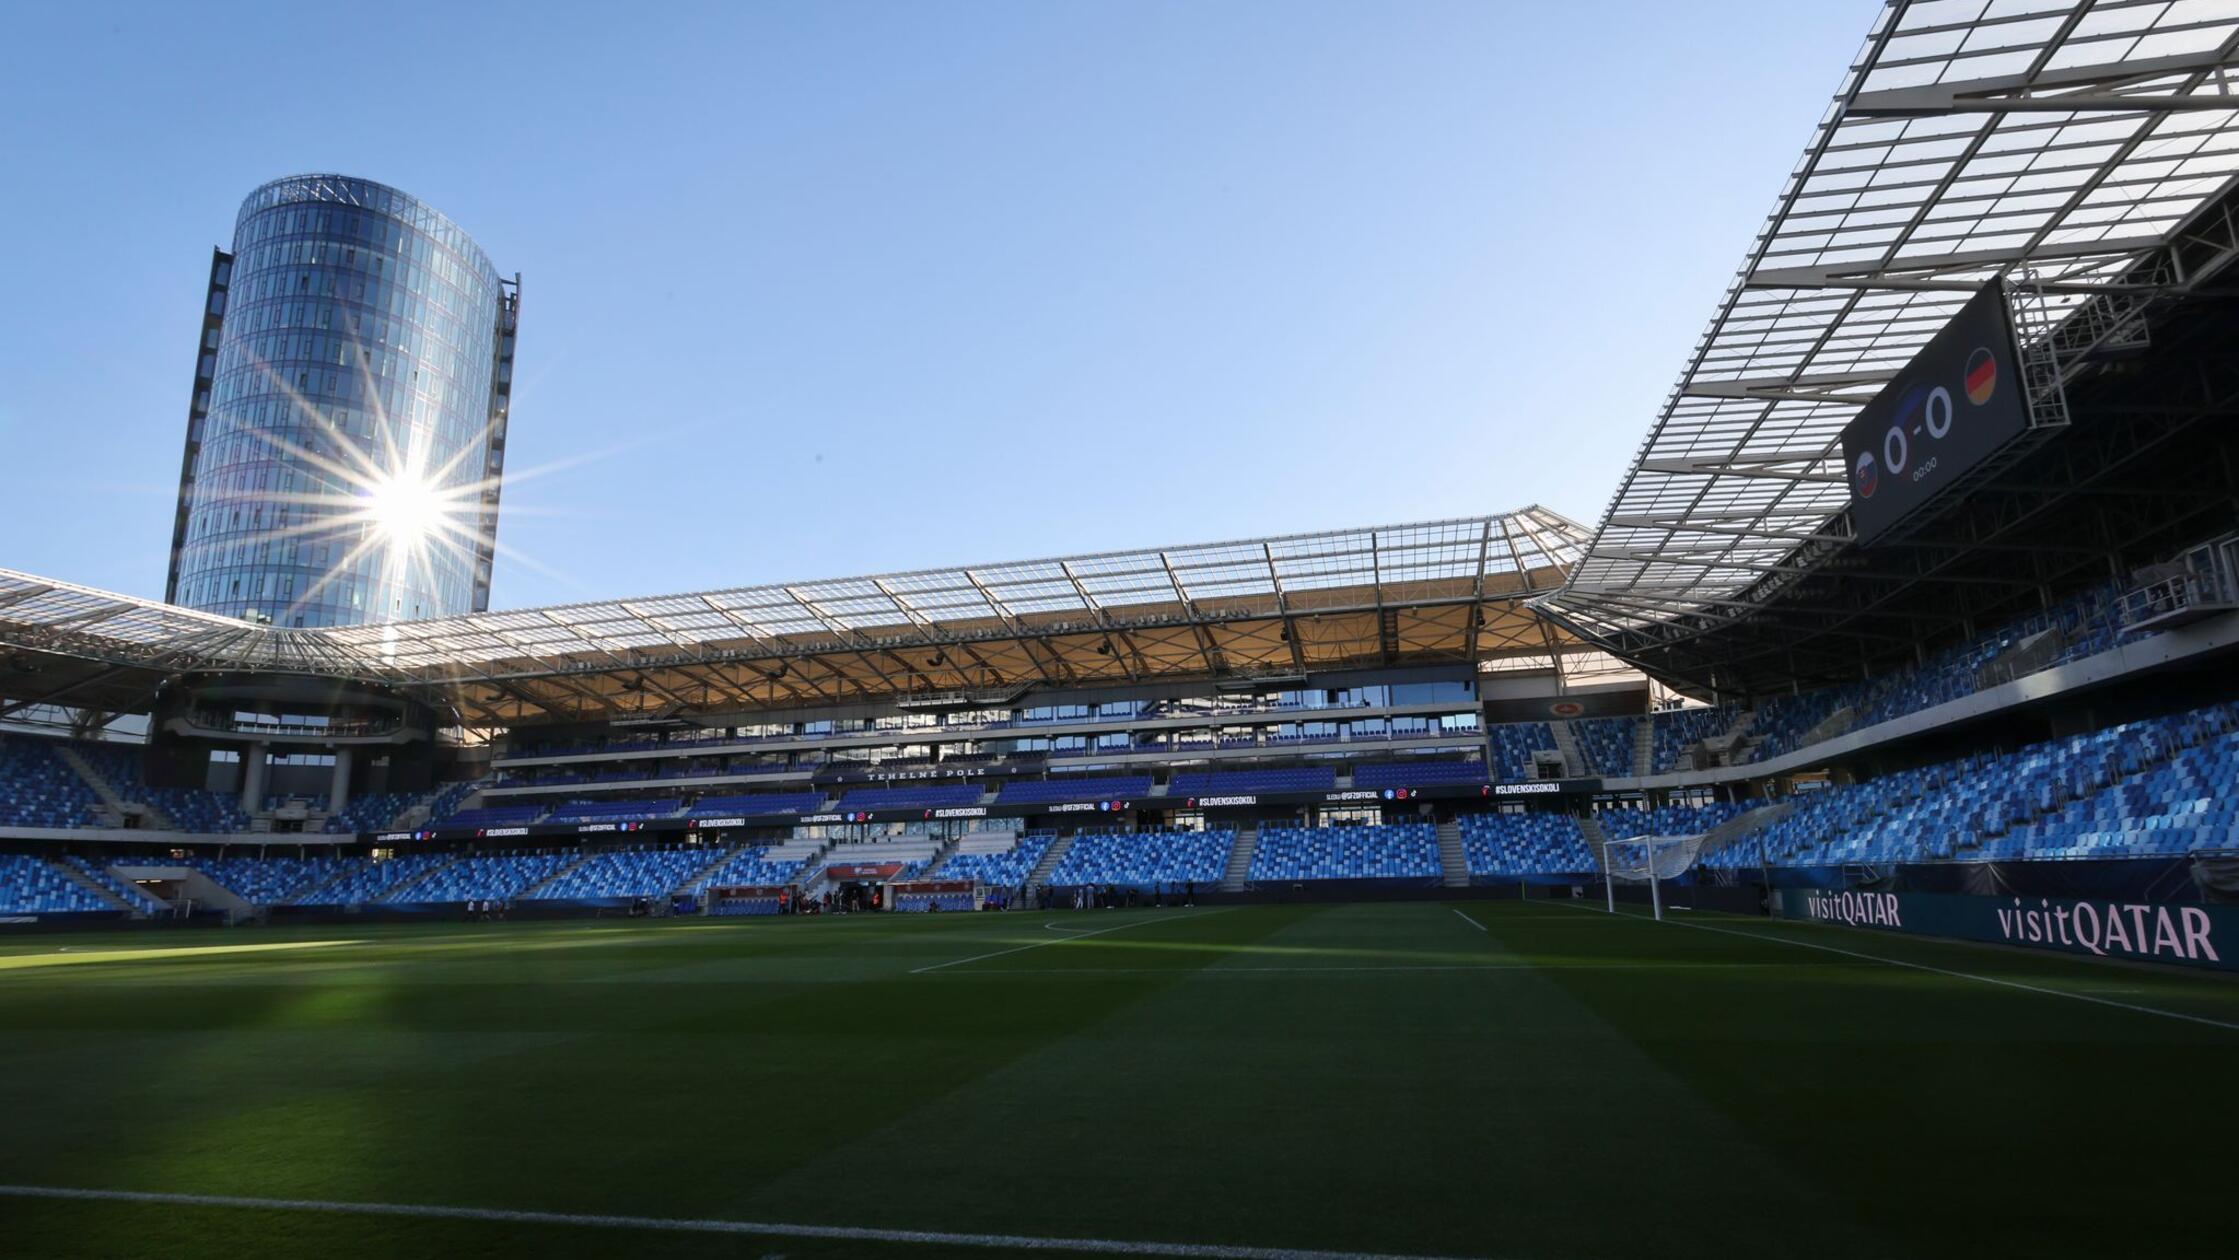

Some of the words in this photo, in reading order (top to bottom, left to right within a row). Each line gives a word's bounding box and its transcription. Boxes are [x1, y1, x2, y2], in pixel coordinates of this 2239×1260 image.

[1913, 456, 1938, 482] 00:00
[946, 768, 985, 777] POLE
[1495, 782, 1560, 795] #SLOVENSKISOKOLI
[1198, 795, 1257, 807] #SLOVENSKISOKOLI
[1808, 889, 1901, 927] visitQATAR
[1997, 897, 2220, 961] visitQATAR
